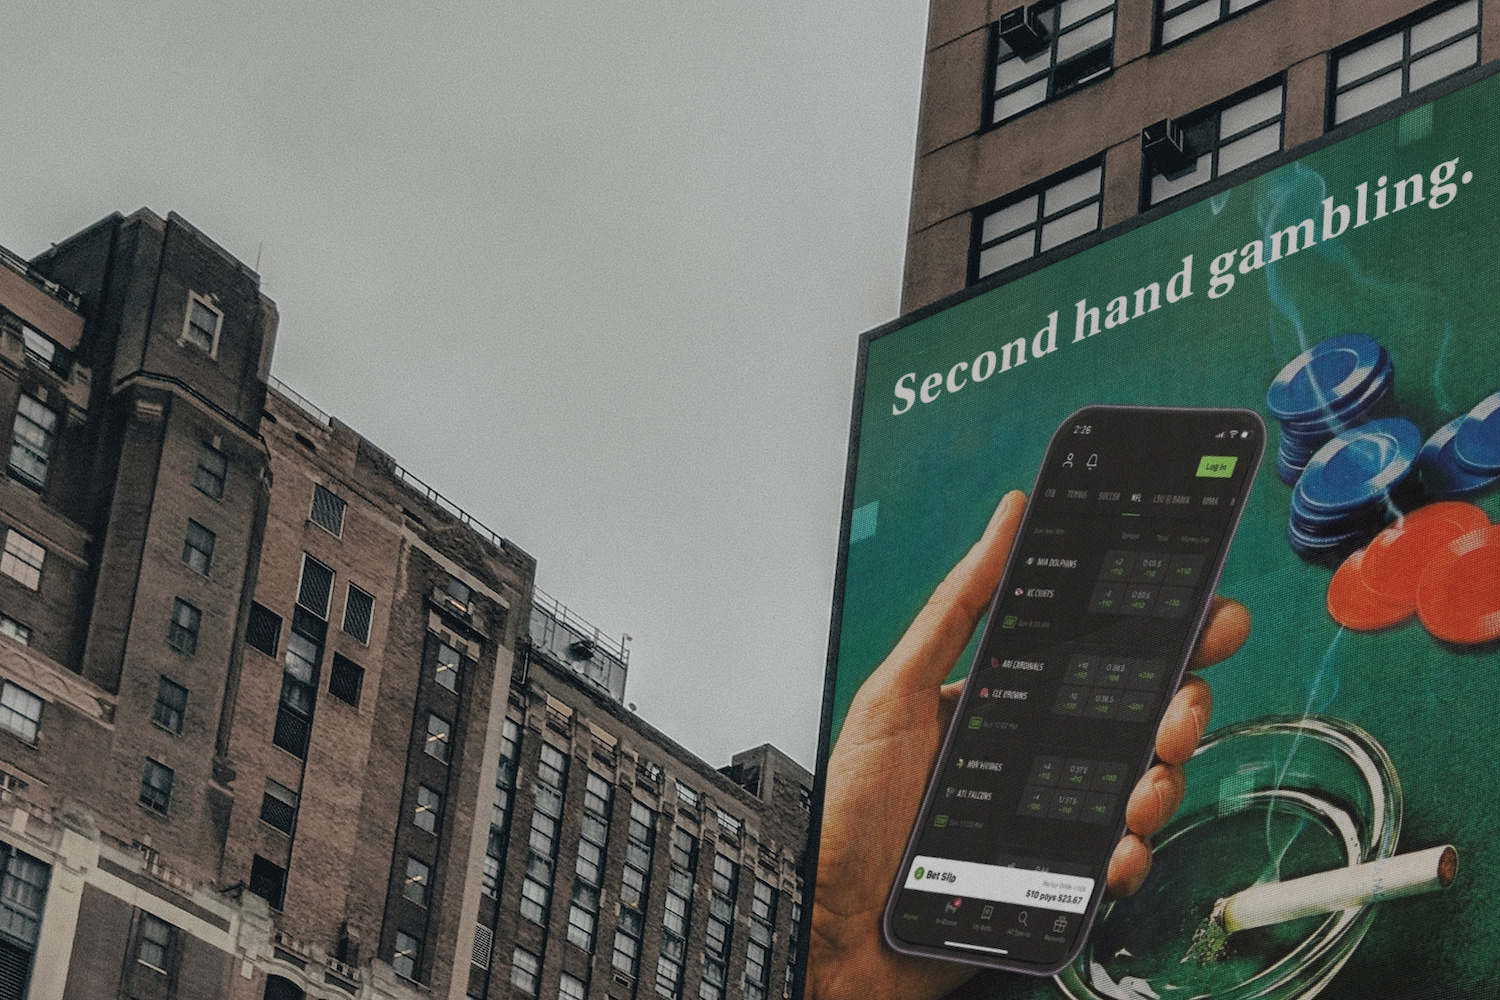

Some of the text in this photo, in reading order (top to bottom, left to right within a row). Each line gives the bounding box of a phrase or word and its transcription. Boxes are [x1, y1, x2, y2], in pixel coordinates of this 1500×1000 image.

[891, 156, 1475, 415] Second hand gambling.
[1074, 425, 1091, 435] 2:26
[1098, 491, 1121, 501] SOCCER
[1131, 493, 1142, 503] NFL
[926, 869, 957, 884] Bet Slip
[1026, 888, 1083, 906] $10 pays $23.67
